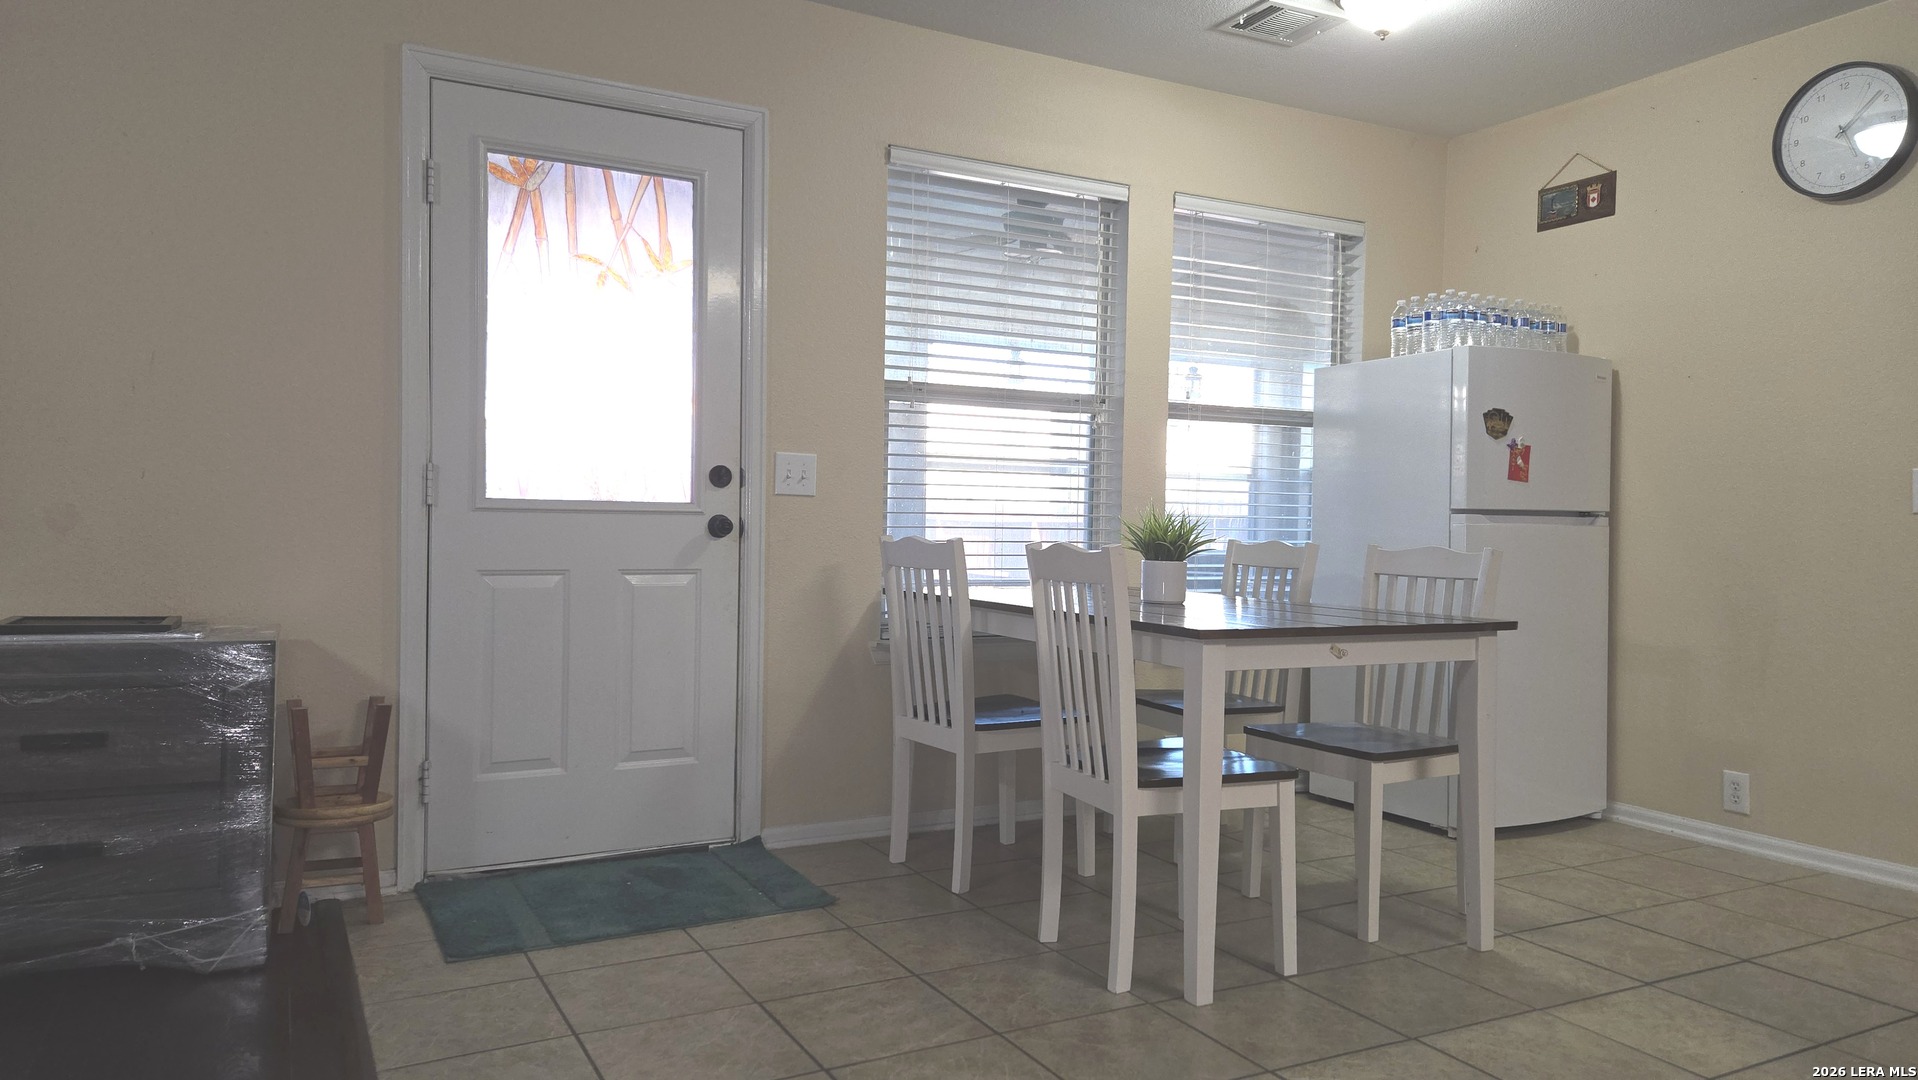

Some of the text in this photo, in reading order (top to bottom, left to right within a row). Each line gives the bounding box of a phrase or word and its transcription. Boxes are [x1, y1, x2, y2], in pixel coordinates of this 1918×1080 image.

[1839, 81, 1850, 91] 12
[1883, 93, 1890, 102] 2
[1800, 115, 1809, 124] 10
[1864, 160, 1870, 169] 5
[1816, 172, 1821, 180] 7
